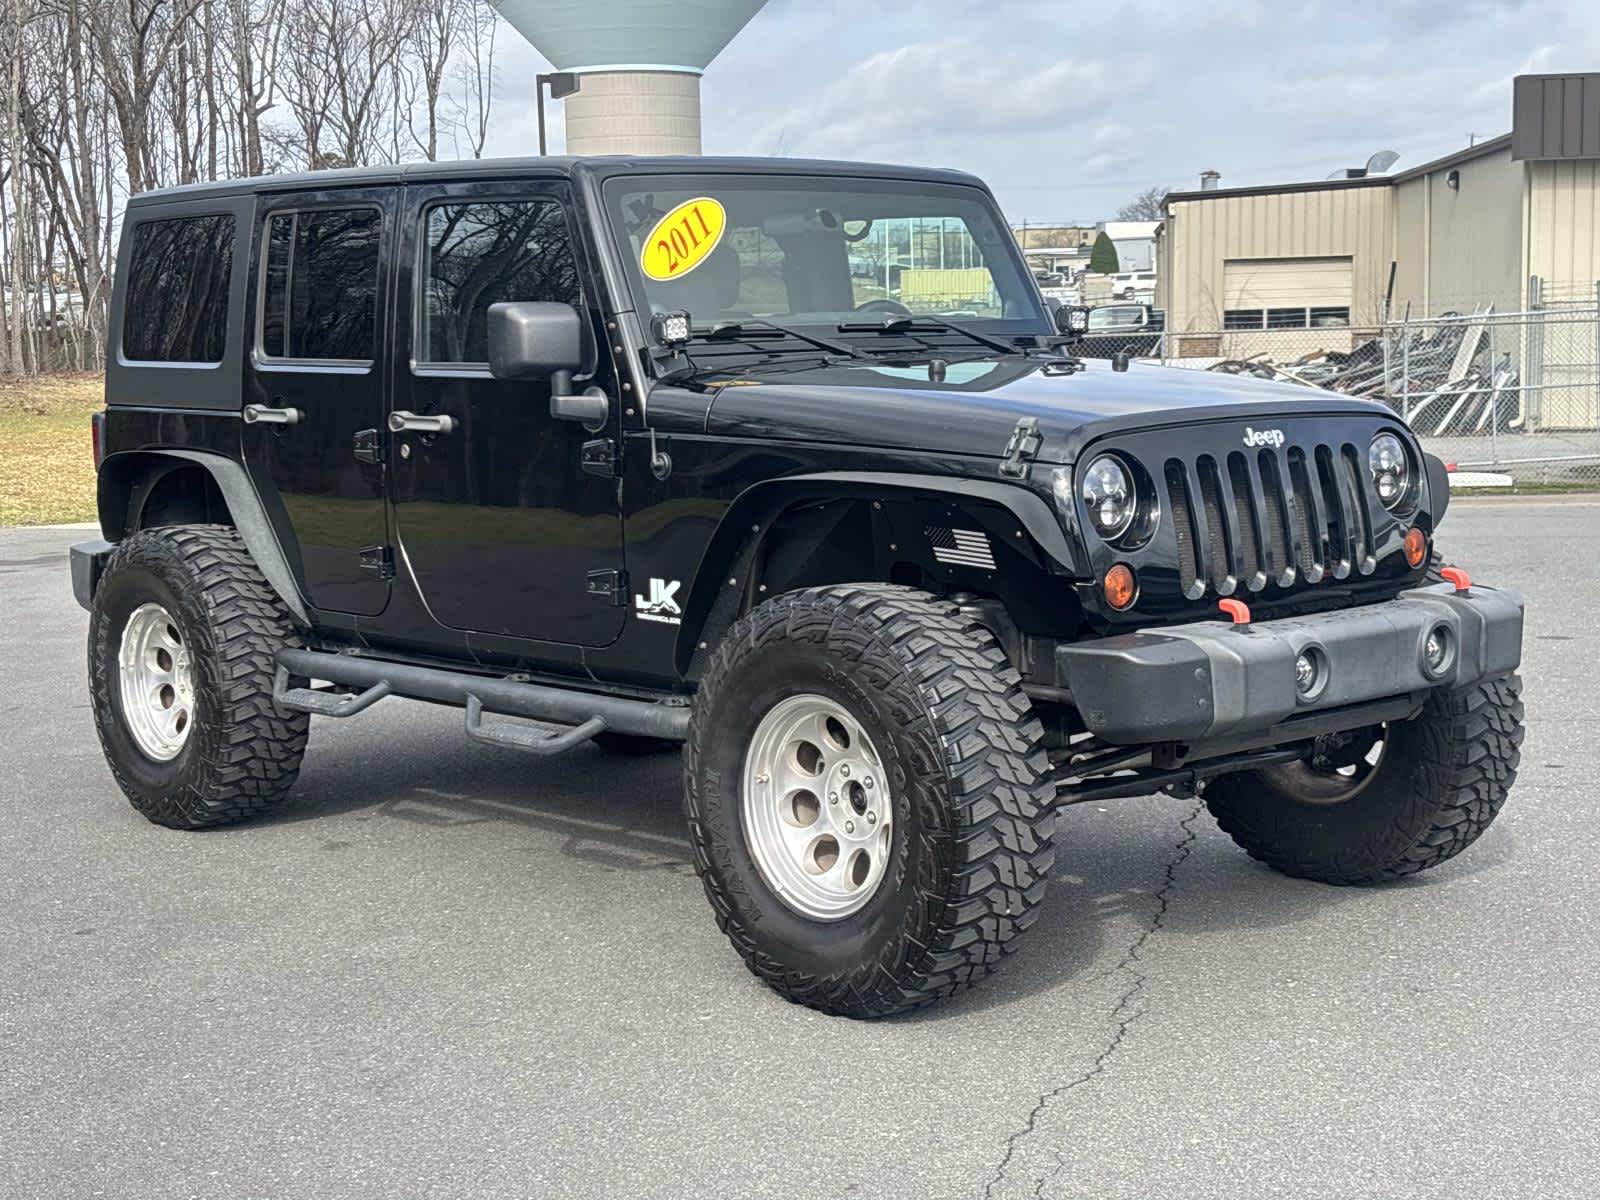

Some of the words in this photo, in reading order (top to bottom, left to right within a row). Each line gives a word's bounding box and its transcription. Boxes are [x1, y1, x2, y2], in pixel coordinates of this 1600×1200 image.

[657, 205, 712, 273] 2011
[1243, 427, 1285, 448] Jeep
[635, 578, 682, 614] JK
